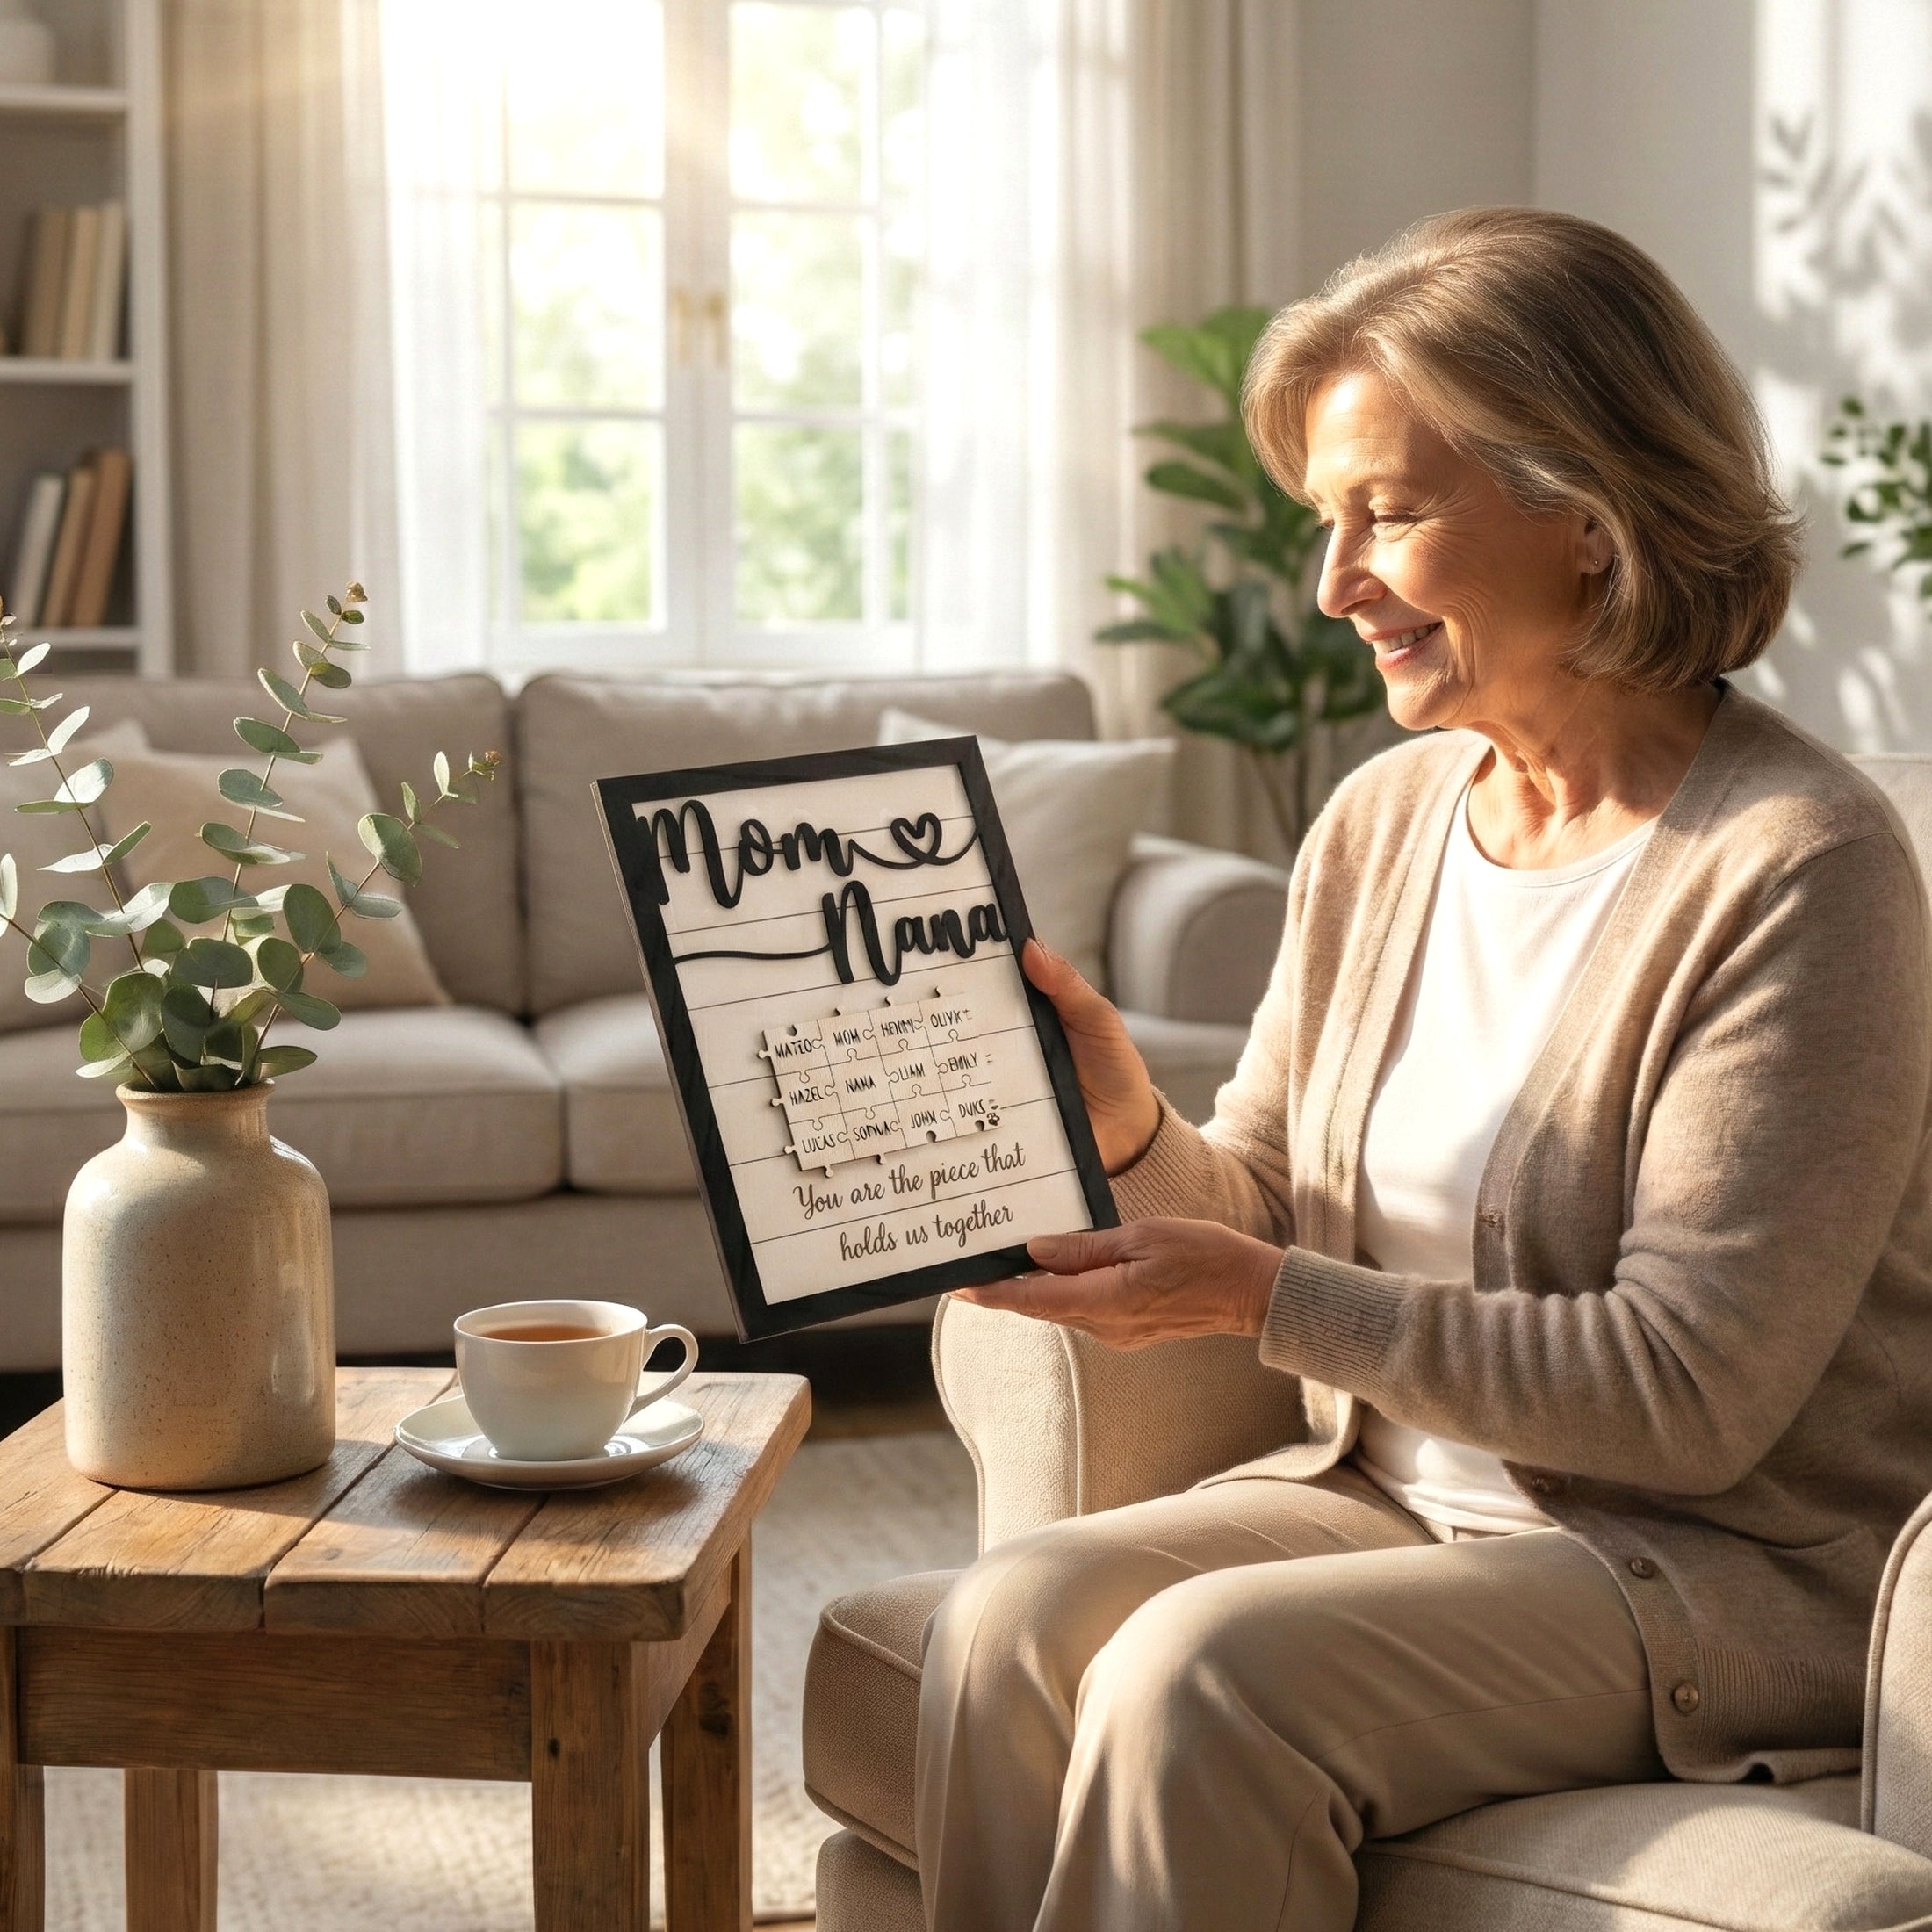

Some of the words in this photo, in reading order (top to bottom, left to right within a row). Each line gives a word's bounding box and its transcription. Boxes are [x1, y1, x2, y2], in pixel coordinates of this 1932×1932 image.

[634, 800, 854, 908] Mom
[821, 880, 1012, 986] Nana
[792, 1183, 843, 1220] You
[850, 1182, 886, 1205] are
[888, 1164, 924, 1195] the
[929, 1161, 980, 1200] piece
[980, 1141, 1027, 1174] that
[840, 1222, 898, 1262] holds
[905, 1225, 929, 1246] us
[931, 1199, 1014, 1249] together
